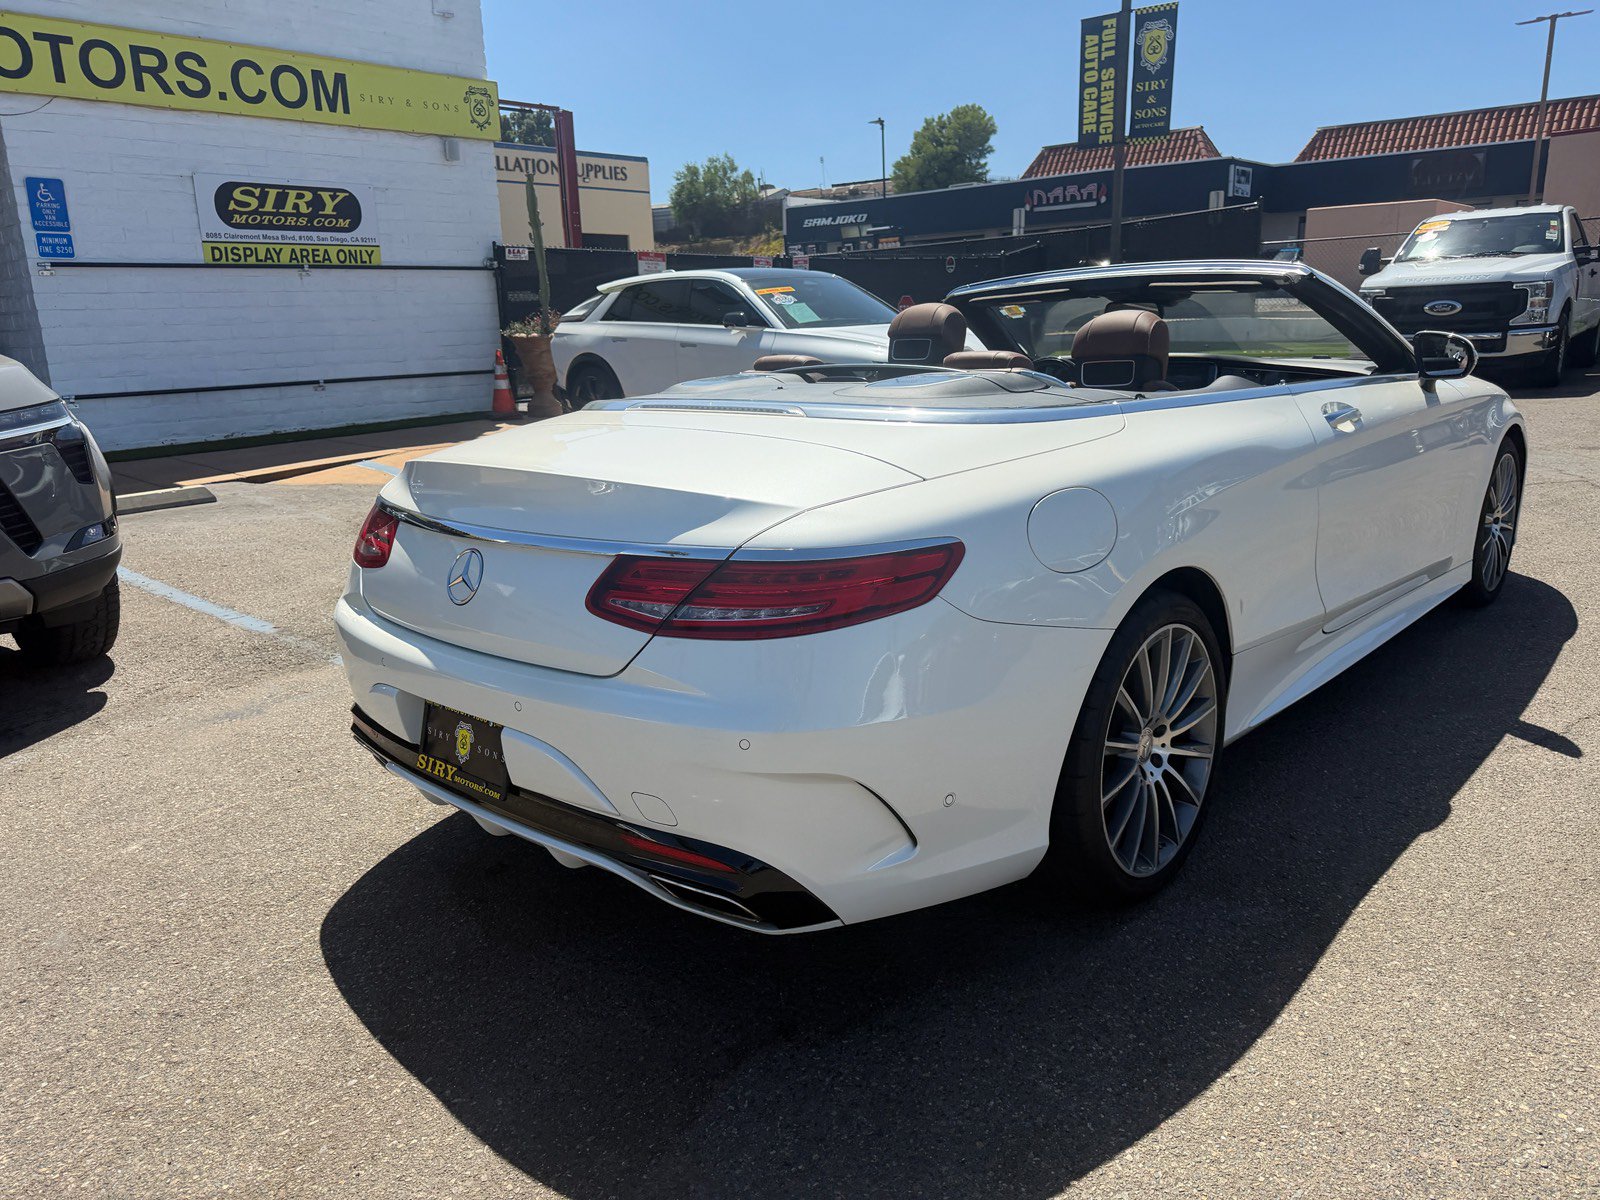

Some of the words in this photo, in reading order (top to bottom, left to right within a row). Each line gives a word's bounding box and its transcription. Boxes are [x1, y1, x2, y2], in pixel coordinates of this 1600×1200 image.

[1101, 17, 1117, 61] FULL
[1083, 34, 1099, 84] AUTO
[1135, 79, 1169, 93] SIRY
[359, 93, 395, 106] SIRY
[405, 98, 413, 108] &
[422, 101, 461, 113] SONS
[1098, 67, 1116, 145] SERVICE
[1146, 94, 1157, 104] &
[1082, 87, 1099, 135] CARE
[1134, 106, 1167, 120] SONS
[494, 154, 559, 176] LLATION
[35, 201, 61, 209] PARKING
[228, 185, 349, 215] SIRY
[34, 220, 69, 228] ACCESSIBLE
[230, 213, 351, 228] MOTORS.COM
[802, 213, 869, 228] SAMJOKO
[41, 236, 68, 245] MINIMUM
[205, 231, 223, 239] 8085
[223, 232, 261, 240] Clairemont
[262, 233, 280, 241] Mesa
[39, 245, 54, 253] FINE
[56, 246, 73, 254] $250
[210, 245, 284, 264] DISPLAY
[288, 247, 333, 264] AREA
[336, 248, 375, 265] ONLY
[427, 726, 451, 742] SIRY
[476, 745, 506, 763] SONS
